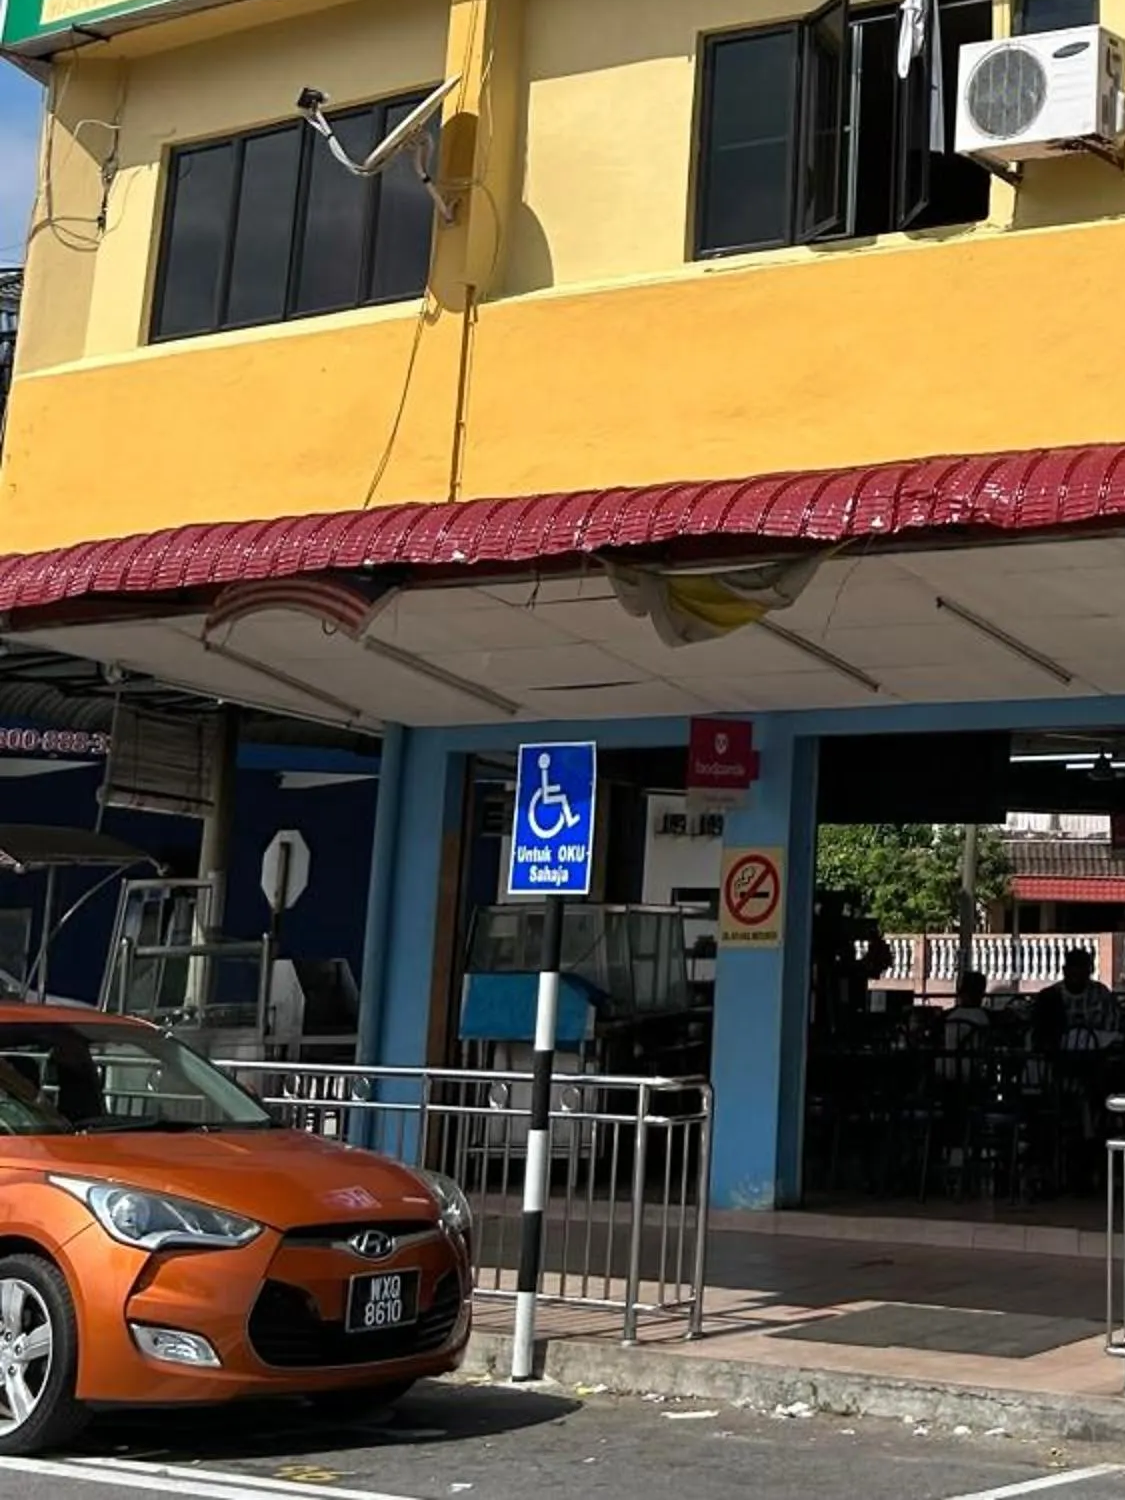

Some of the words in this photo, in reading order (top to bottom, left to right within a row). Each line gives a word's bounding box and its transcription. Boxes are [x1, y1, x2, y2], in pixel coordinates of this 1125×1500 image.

[517, 844, 552, 863] Untuk
[558, 844, 586, 863] OKU
[529, 864, 569, 887] Sahaja
[364, 1299, 402, 1326] 8610
